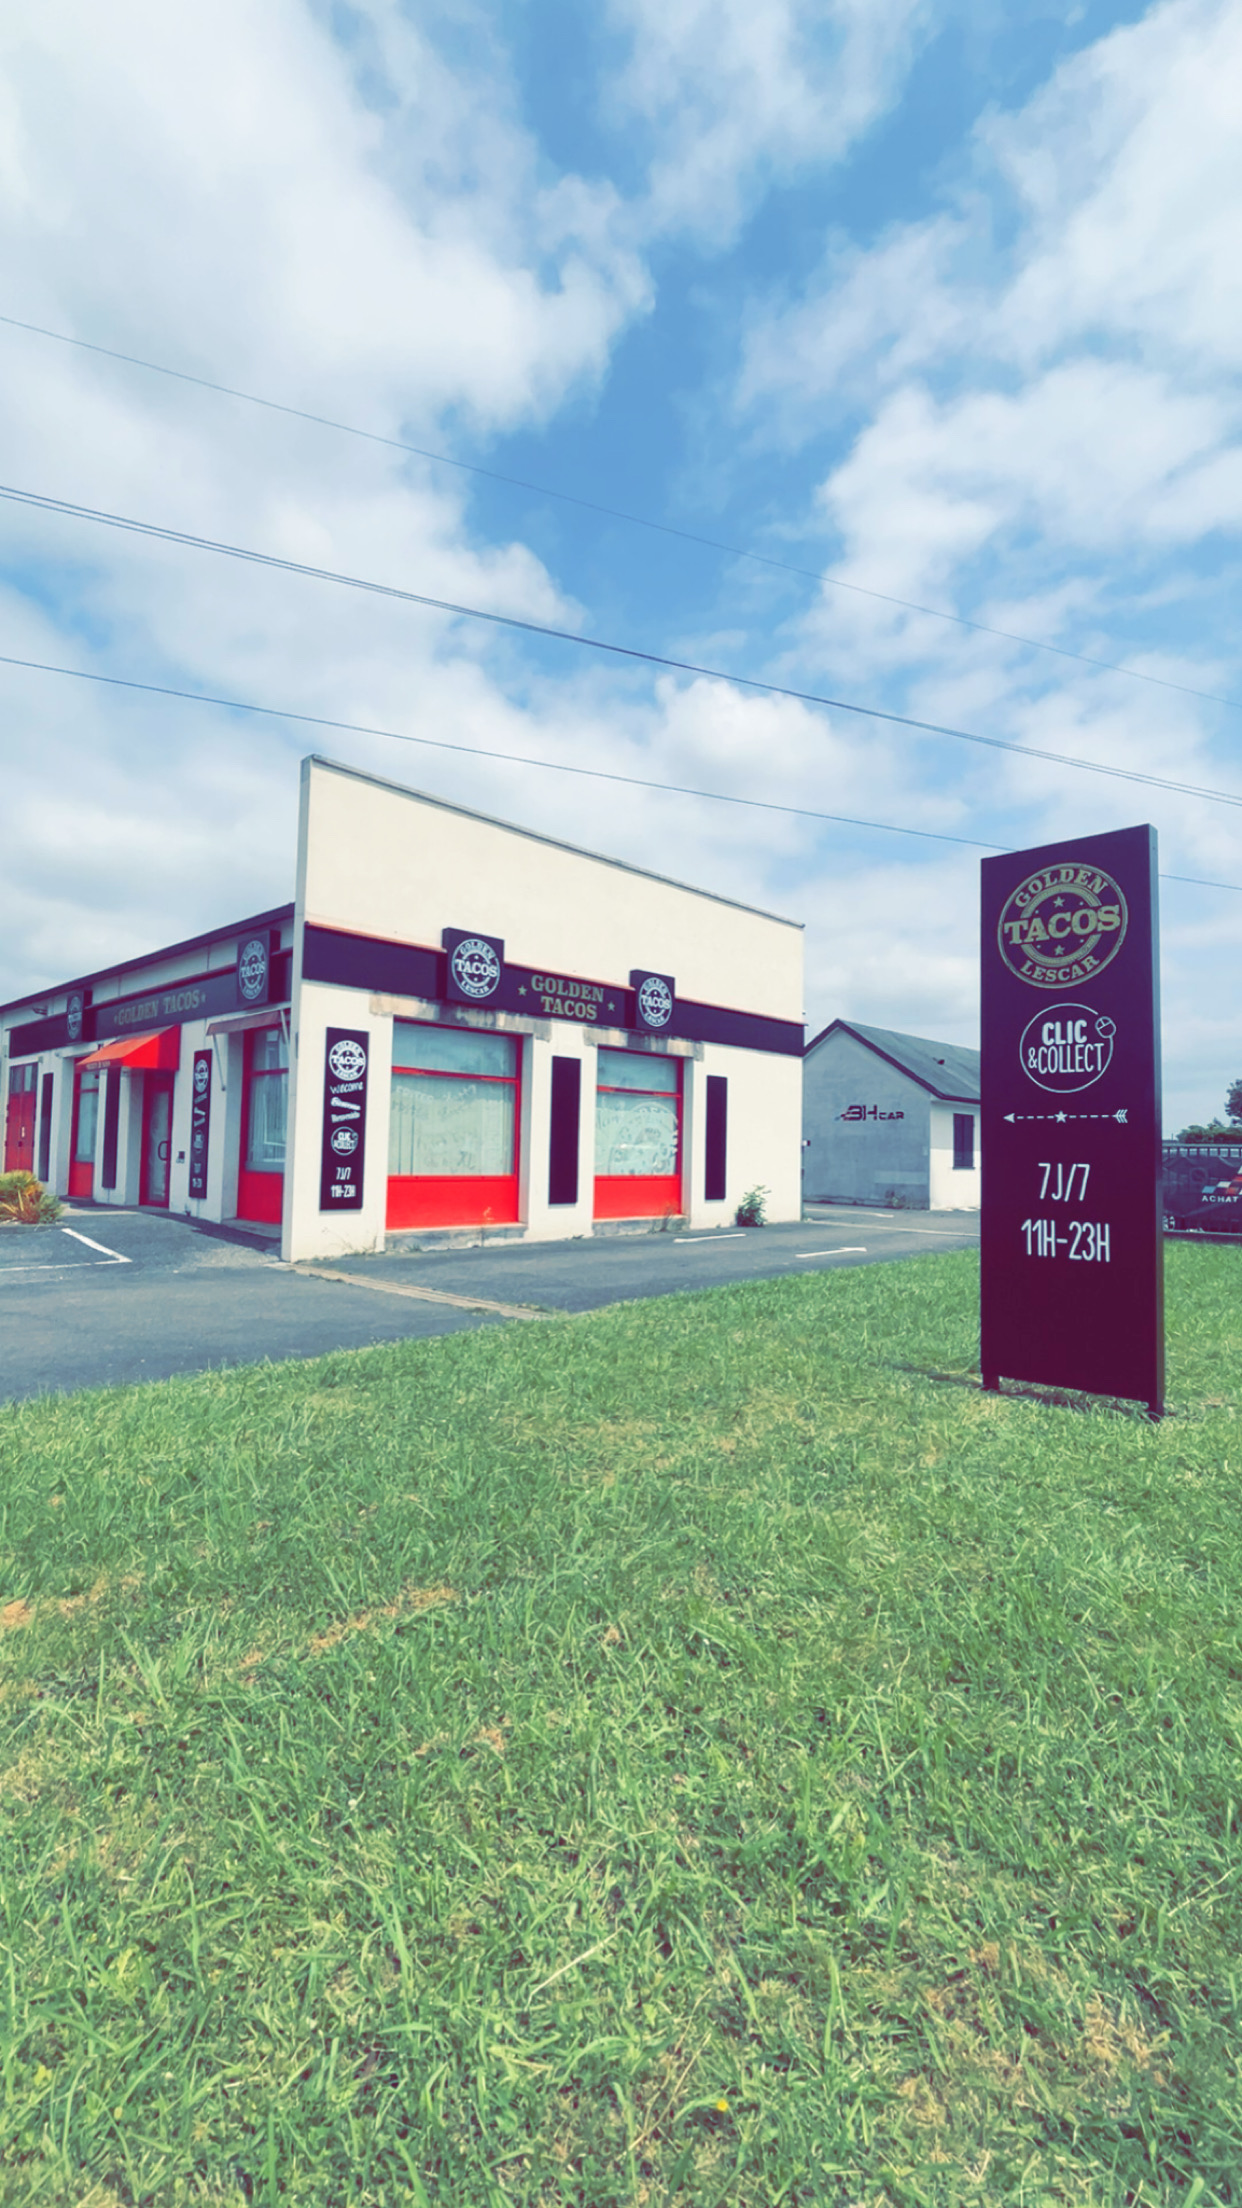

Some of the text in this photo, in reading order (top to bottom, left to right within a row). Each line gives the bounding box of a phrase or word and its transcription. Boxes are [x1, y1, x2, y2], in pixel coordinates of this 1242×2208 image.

[1015, 868, 1109, 908] GOLDEN
[1004, 904, 1121, 945] TACOS
[460, 941, 496, 960] GOLDEN
[241, 961, 265, 978] TACOS
[455, 958, 498, 978] TACOS
[1020, 955, 1100, 982] LESCAR
[531, 974, 605, 1003] GOLDEN
[118, 989, 200, 1025] GOLDEN TACOS
[541, 995, 598, 1021] TACOS
[641, 994, 671, 1010] TACOS
[1041, 1019, 1088, 1045] CLIC
[331, 1055, 365, 1066] TACOS
[1028, 1043, 1105, 1074] &COLLECT
[1038, 1163, 1090, 1202] 7J/7
[1202, 1195, 1239, 1203] ACHAT
[1020, 1218, 1111, 1263] 11H-23H
